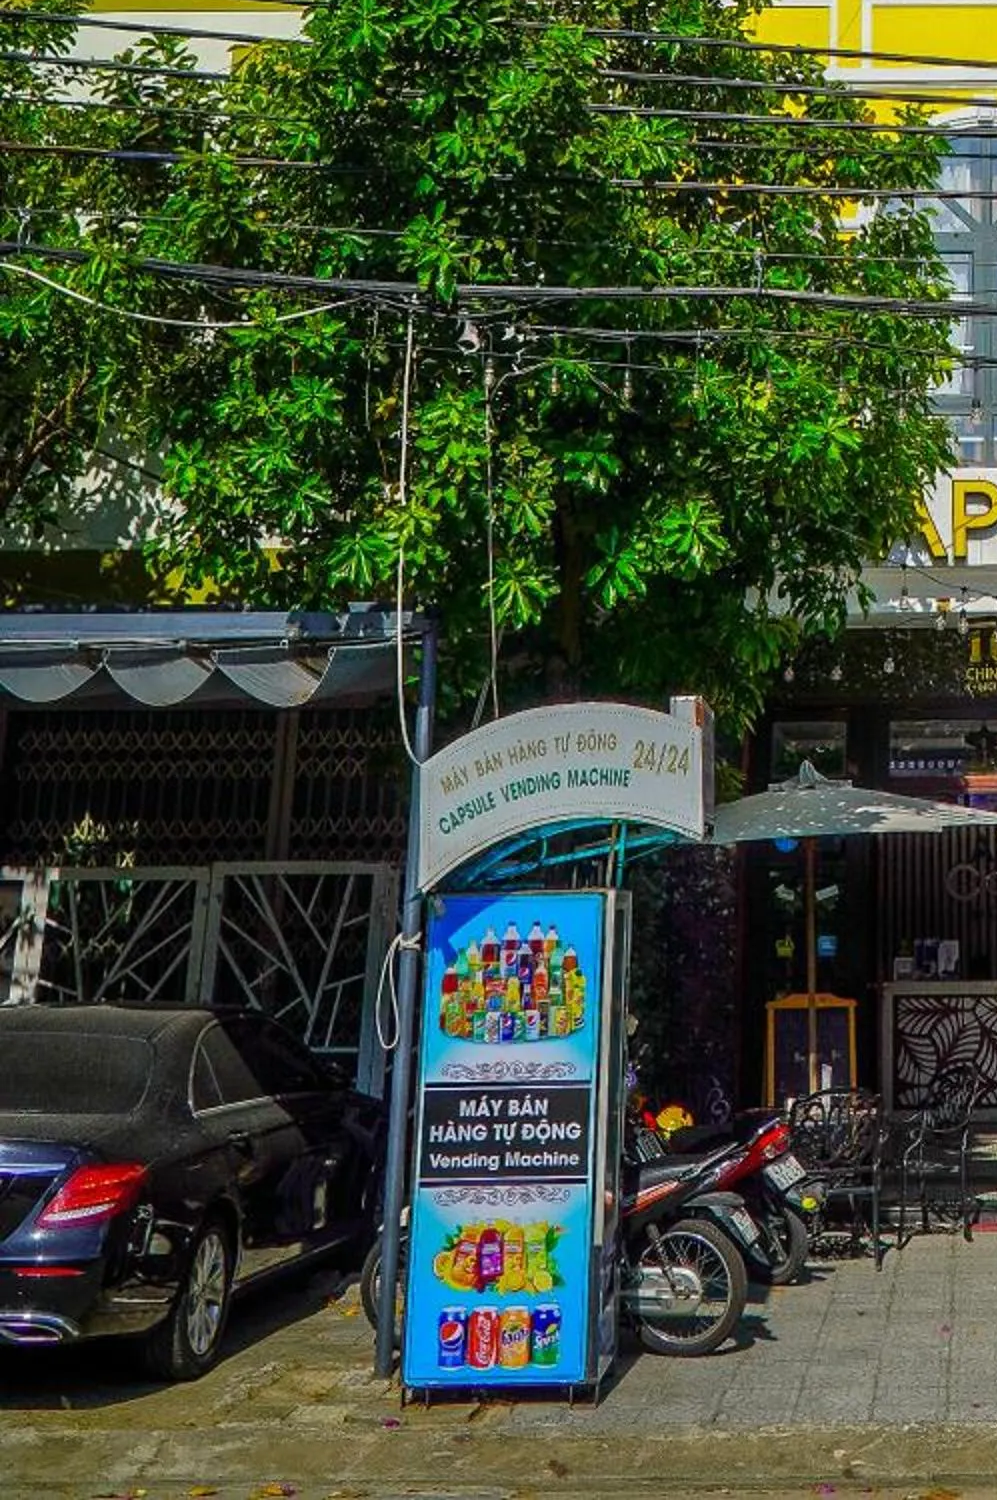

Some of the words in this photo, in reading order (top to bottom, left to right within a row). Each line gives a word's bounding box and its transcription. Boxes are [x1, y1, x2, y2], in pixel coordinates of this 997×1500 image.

[474, 750, 504, 777] BÁN
[508, 739, 548, 766] HÀNG
[632, 740, 691, 776] 24/24
[438, 791, 497, 835] CAPSULE
[500, 770, 561, 803] VENDING
[567, 767, 631, 789] MACHINE
[459, 1094, 502, 1117] MÁY
[507, 1094, 549, 1117] BÁN
[429, 1119, 488, 1143] HÀNG
[493, 1121, 517, 1145] TỰ
[521, 1118, 582, 1145] ĐỘNG
[429, 1153, 500, 1171] Vending
[505, 1151, 580, 1167] Machine
